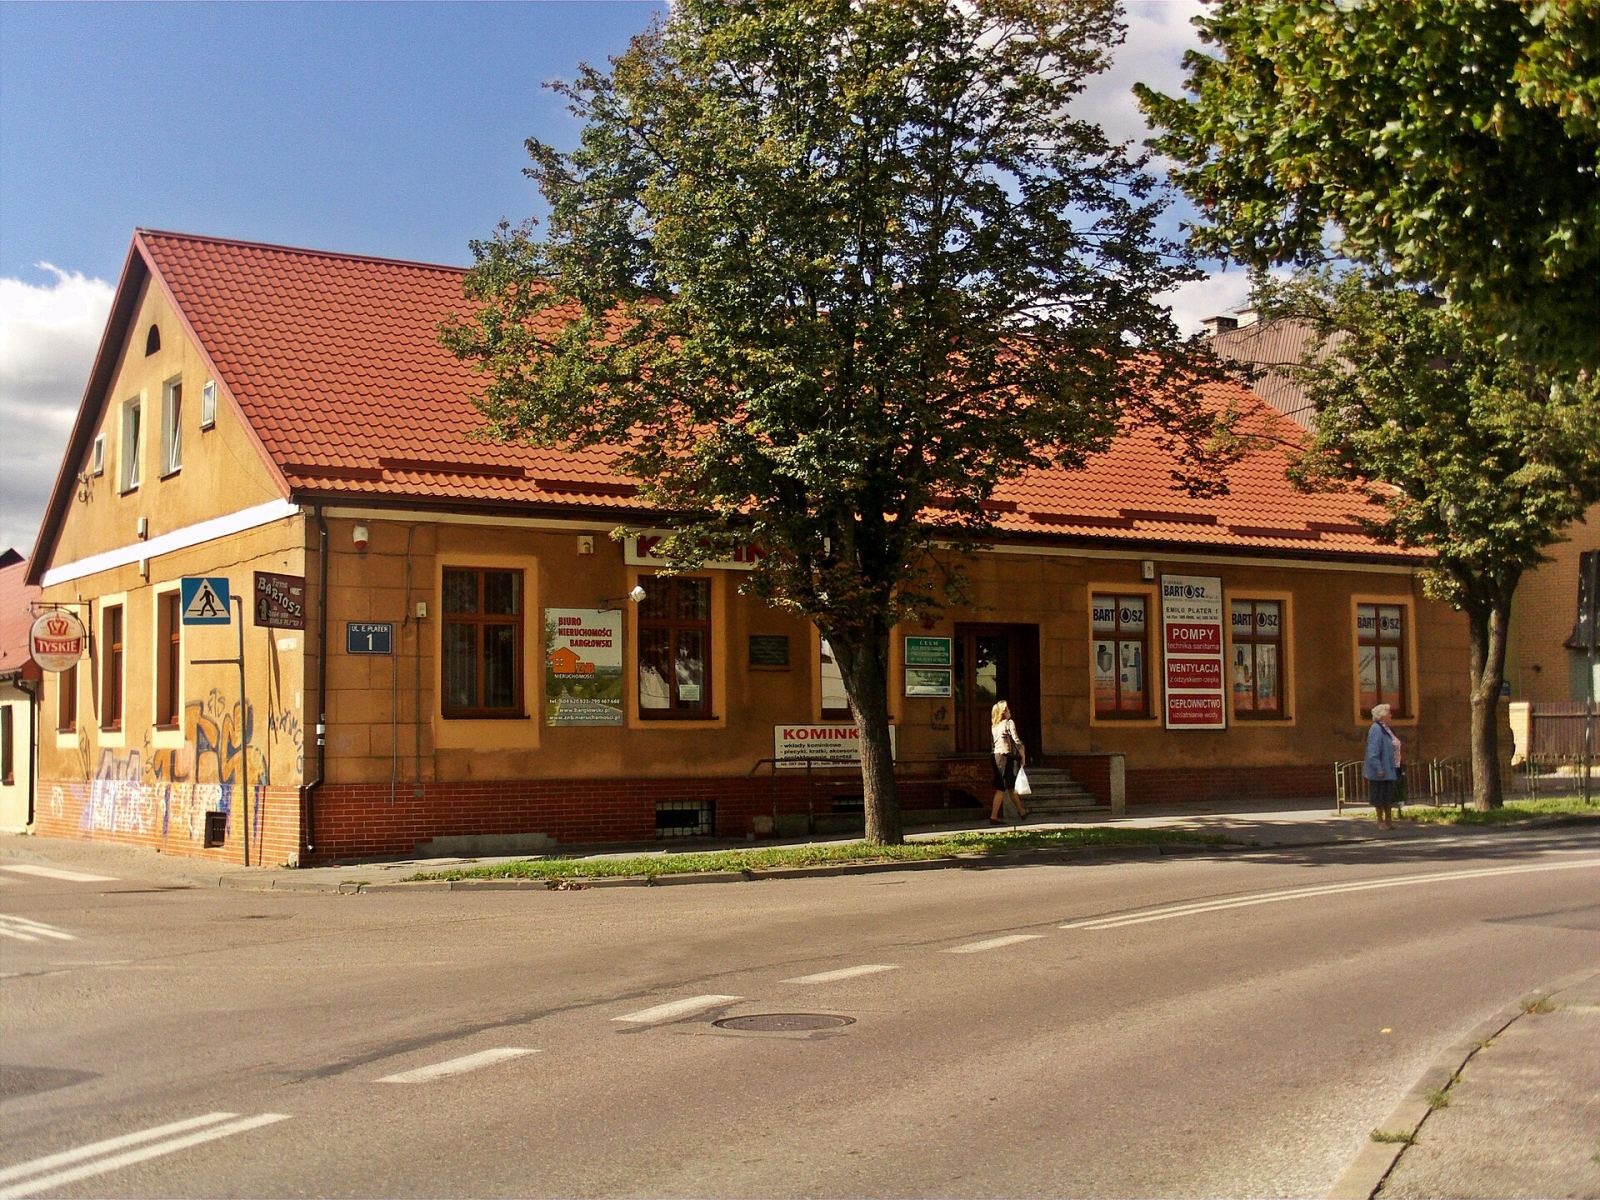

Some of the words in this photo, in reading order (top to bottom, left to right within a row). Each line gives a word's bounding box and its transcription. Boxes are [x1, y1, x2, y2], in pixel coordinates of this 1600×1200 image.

[257, 576, 302, 617] BARTOSZ
[1164, 584, 1205, 599] BARTOSZ
[1093, 607, 1143, 623] BARTOSZ
[1232, 612, 1278, 627] BARTOSZ
[558, 617, 582, 626] BIURO
[1358, 616, 1400, 630] BARTOSZ
[558, 627, 612, 637] NIERUCHOMOŚCI
[1172, 628, 1214, 640] POMPY
[37, 639, 78, 652] TYSKIE
[366, 633, 373, 651] 1
[569, 639, 612, 648] BARGŁOWSKI
[1169, 663, 1220, 673] WENTYLACJA
[1169, 698, 1221, 709] CIEPŁOWNICTWO
[783, 728, 860, 740] KOMINK
